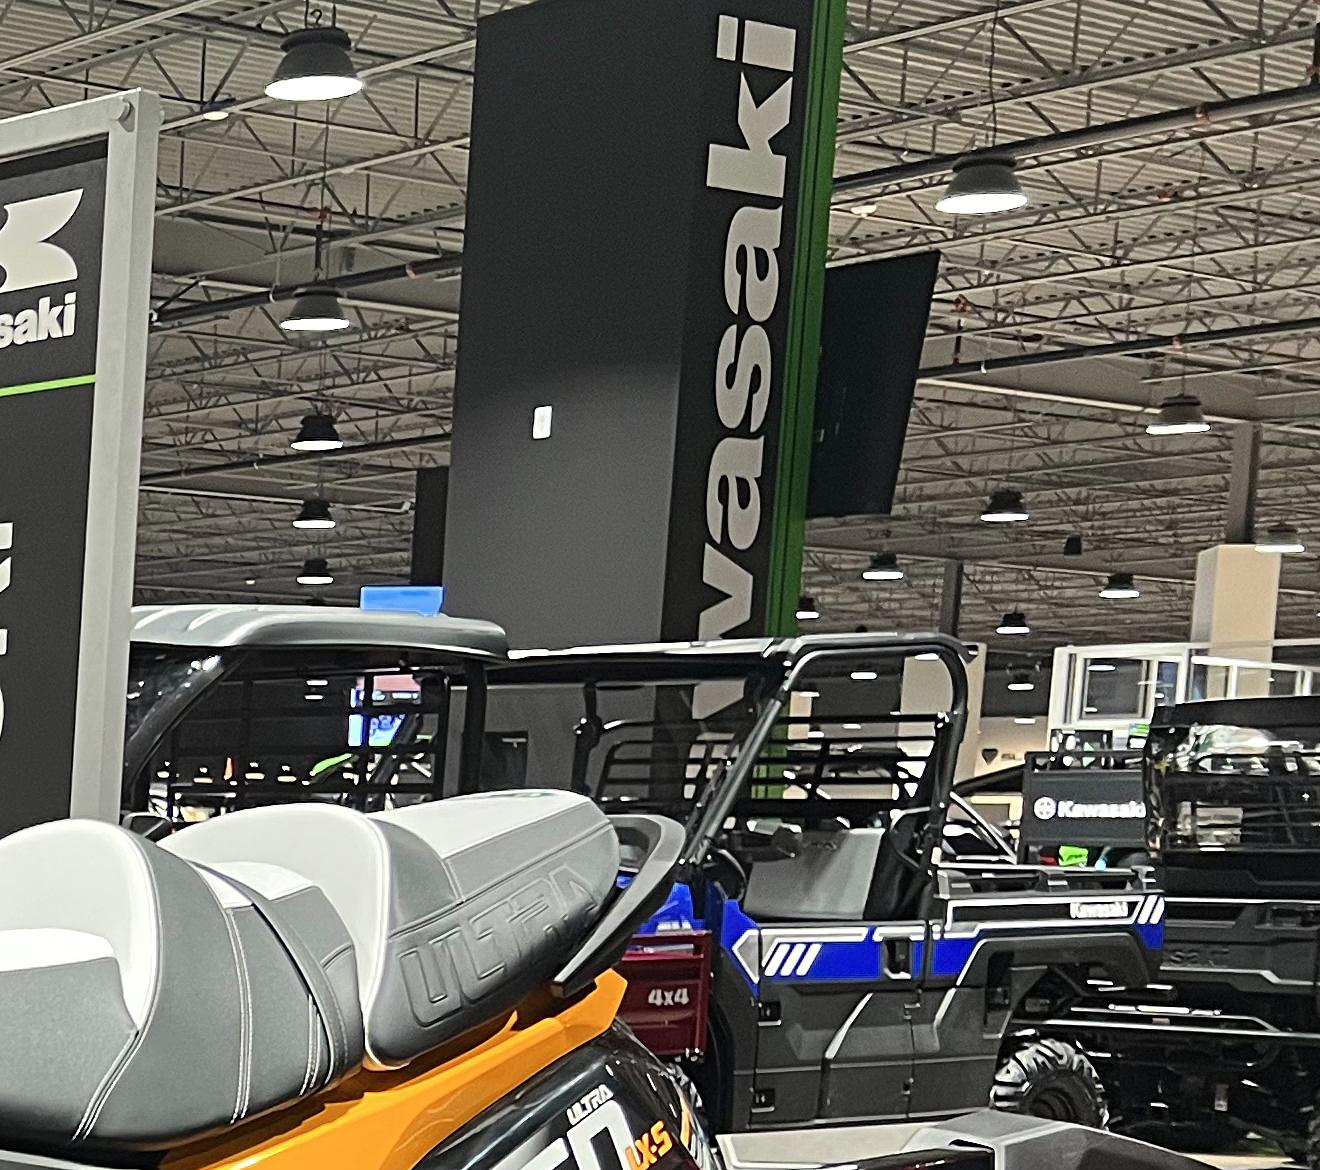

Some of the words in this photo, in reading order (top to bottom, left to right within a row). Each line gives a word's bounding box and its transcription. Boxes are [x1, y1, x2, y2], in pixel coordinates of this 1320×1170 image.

[683, 14, 797, 800] wasaki
[398, 865, 600, 1030] ULTRA
[648, 988, 690, 1007] 4x4
[566, 1084, 614, 1126] ULTRA
